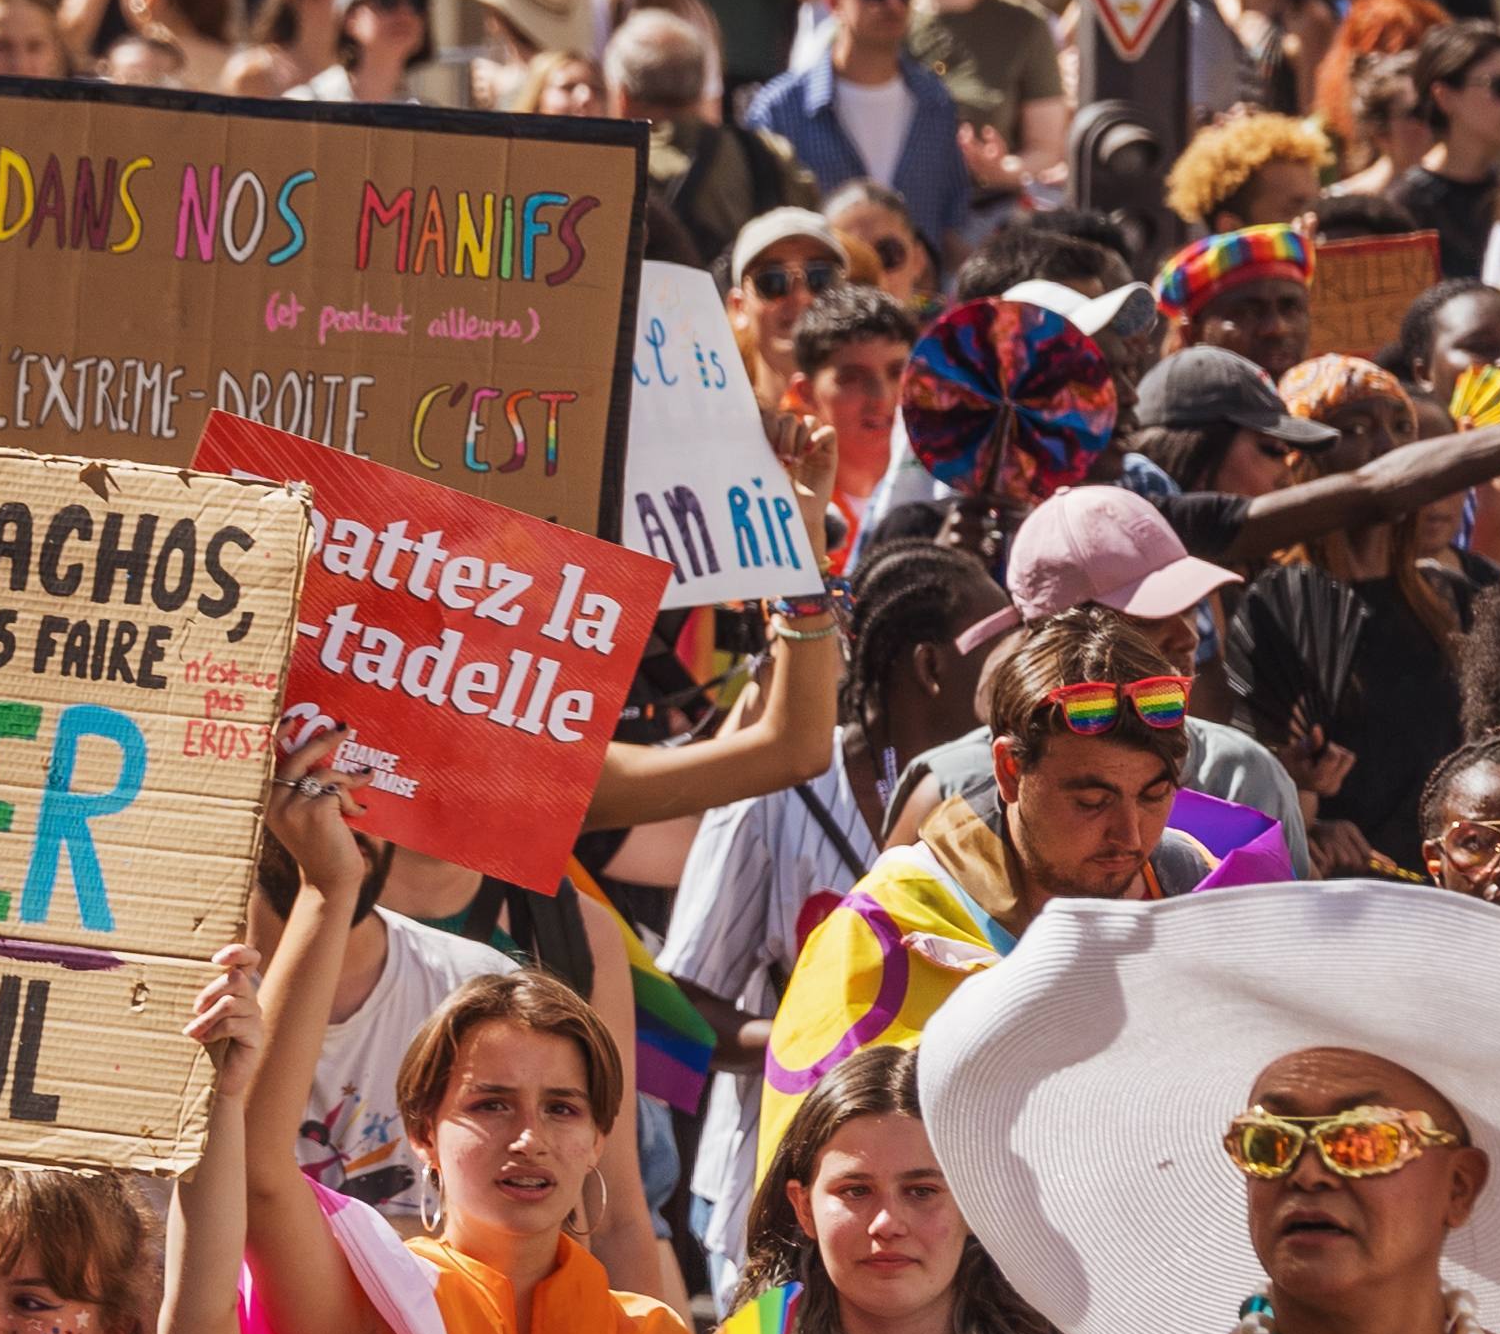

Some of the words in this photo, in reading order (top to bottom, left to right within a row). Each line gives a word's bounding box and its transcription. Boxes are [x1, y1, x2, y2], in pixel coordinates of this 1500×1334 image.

[175, 163, 317, 267] NOS
[355, 180, 602, 287] MANIFS
[265, 291, 300, 333] (et
[317, 304, 412, 346] partout
[427, 306, 542, 343] ailleurs)
[693, 341, 728, 391] is
[412, 380, 579, 476] C'EST
[542, 562, 626, 656] la
[34, 614, 173, 690] FAIRE
[185, 653, 277, 691] n'est-ce
[204, 689, 246, 718] pas
[337, 740, 401, 773] FRANCE
